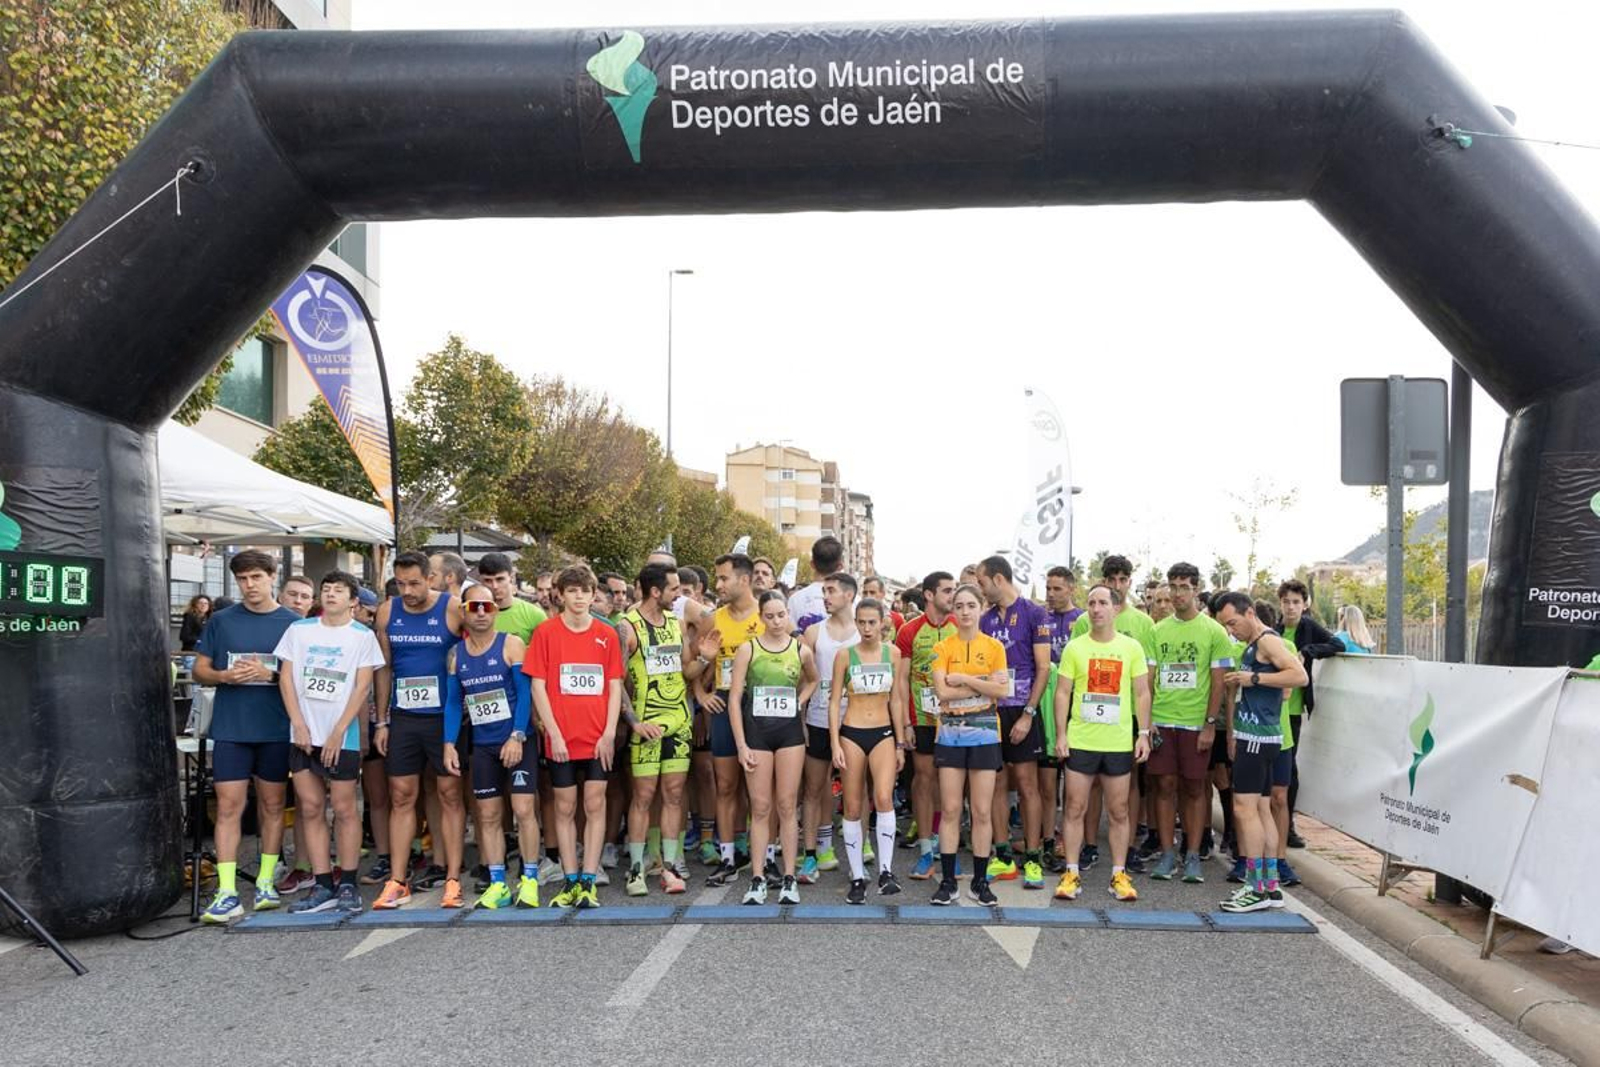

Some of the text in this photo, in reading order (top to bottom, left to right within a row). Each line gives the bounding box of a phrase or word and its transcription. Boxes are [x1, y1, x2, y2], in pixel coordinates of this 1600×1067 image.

[670, 57, 1024, 92] Patronato Municipal de
[671, 93, 941, 135] Deportes de Jaén
[1011, 538, 1034, 586] CSIF
[1528, 587, 1600, 604] Patronat
[9, 618, 31, 632] de
[389, 635, 442, 643] TROTASIERRA
[655, 655, 675, 667] 361
[570, 675, 596, 688] 306
[860, 674, 884, 686] 177
[1167, 672, 1190, 683] 222
[307, 678, 337, 693] 285
[405, 688, 430, 702] 192
[475, 702, 501, 717] 382
[763, 698, 788, 710] 115
[1096, 704, 1105, 717] 5
[1406, 800, 1441, 820] Municipal
[1441, 810, 1452, 824] de
[1411, 818, 1422, 830] de
